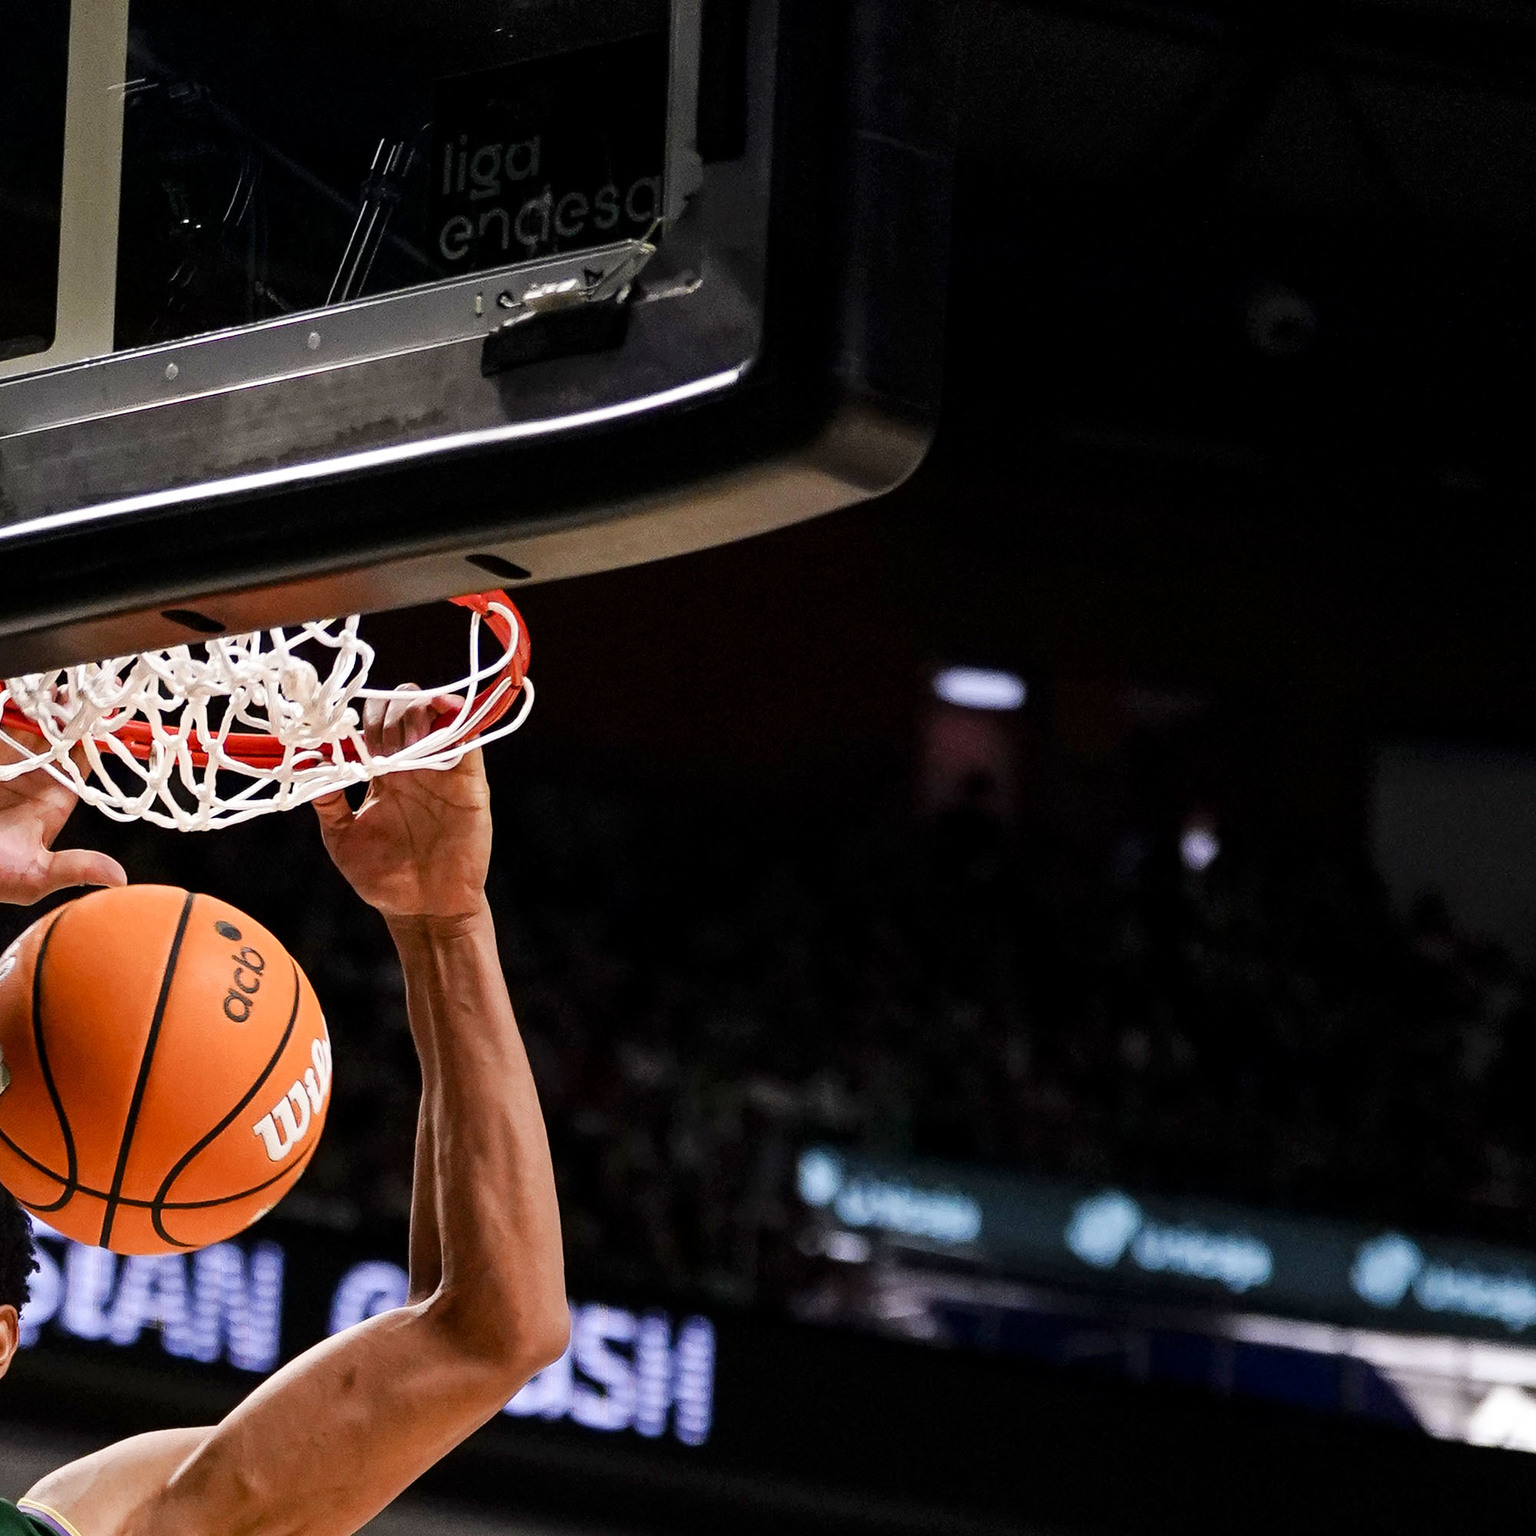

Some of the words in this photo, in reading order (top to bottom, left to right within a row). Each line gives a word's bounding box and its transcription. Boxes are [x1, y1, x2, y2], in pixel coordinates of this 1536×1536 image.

[442, 134, 541, 200] liga
[439, 176, 664, 261] endesa
[223, 946, 265, 1023] acb
